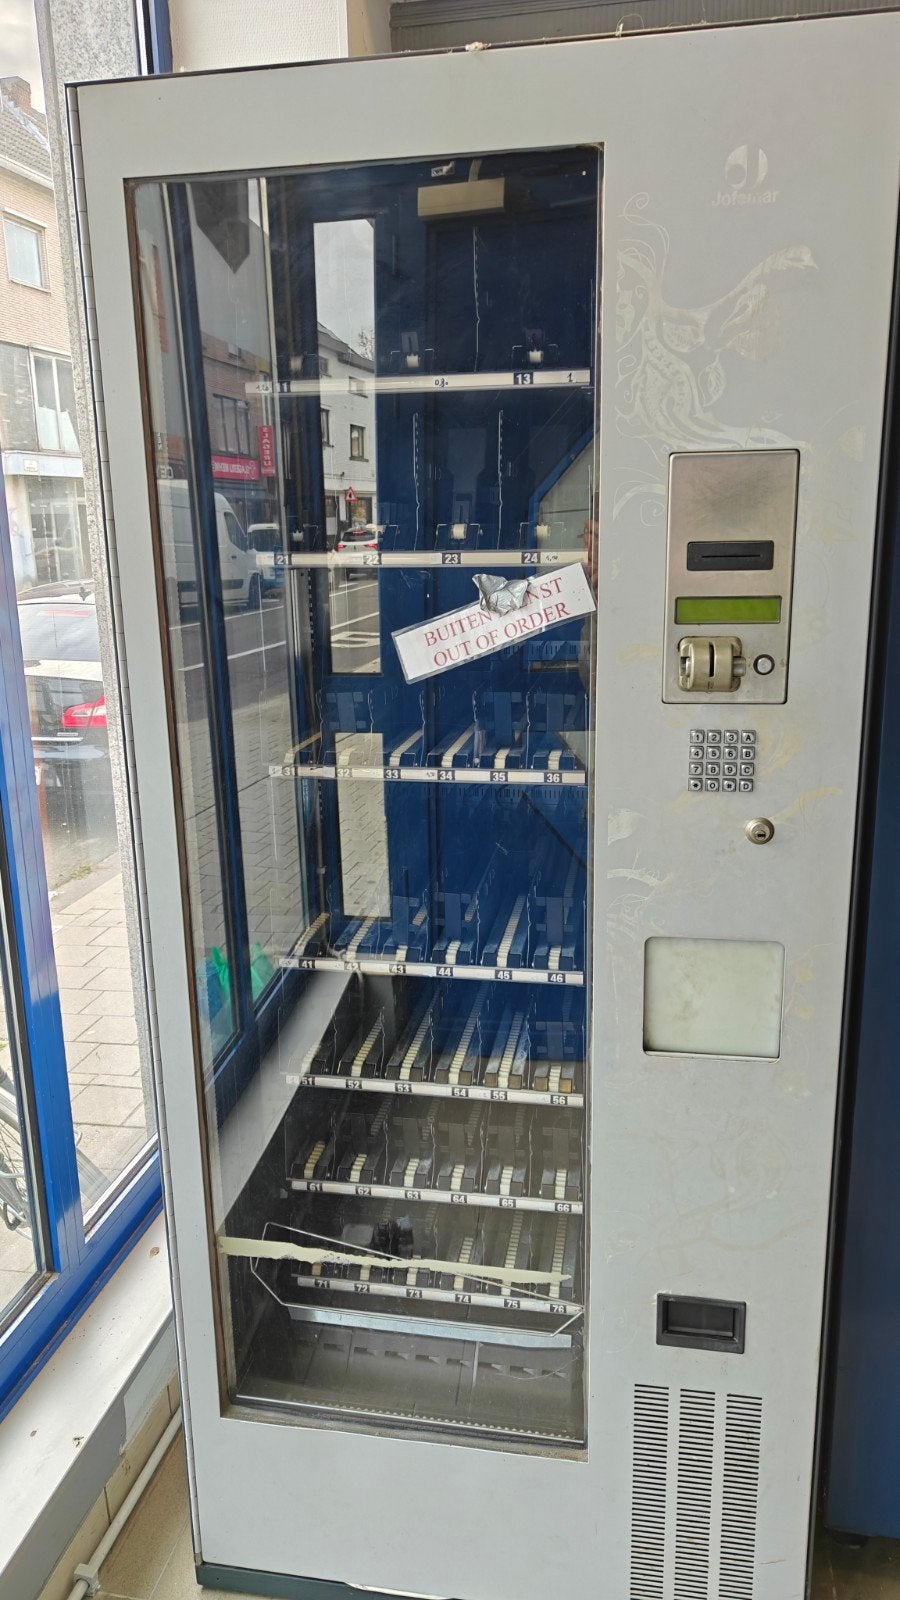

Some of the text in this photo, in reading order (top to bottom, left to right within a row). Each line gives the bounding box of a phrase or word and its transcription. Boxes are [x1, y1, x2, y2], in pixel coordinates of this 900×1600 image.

[516, 373, 530, 384] 13
[277, 555, 289, 565] 21
[366, 555, 379, 565] 22
[445, 554, 458, 564] 23
[524, 553, 538, 563] 24
[424, 611, 492, 646] BUITEN
[433, 602, 571, 666] OUT OF ORDER
[337, 768, 350, 778] 32
[386, 770, 399, 779] 33
[439, 770, 453, 780] 34
[492, 772, 506, 782] 35
[546, 773, 560, 783] 36
[391, 965, 404, 973] 43
[438, 967, 451, 976] 44
[497, 970, 510, 980] 45
[550, 974, 563, 983] 46
[302, 1077, 566, 1105] 51 52 53 54 55 56
[309, 1183, 570, 1212] 61 62 63 64 65 66
[317, 1280, 565, 1313] 71 72 73 74 75 76
